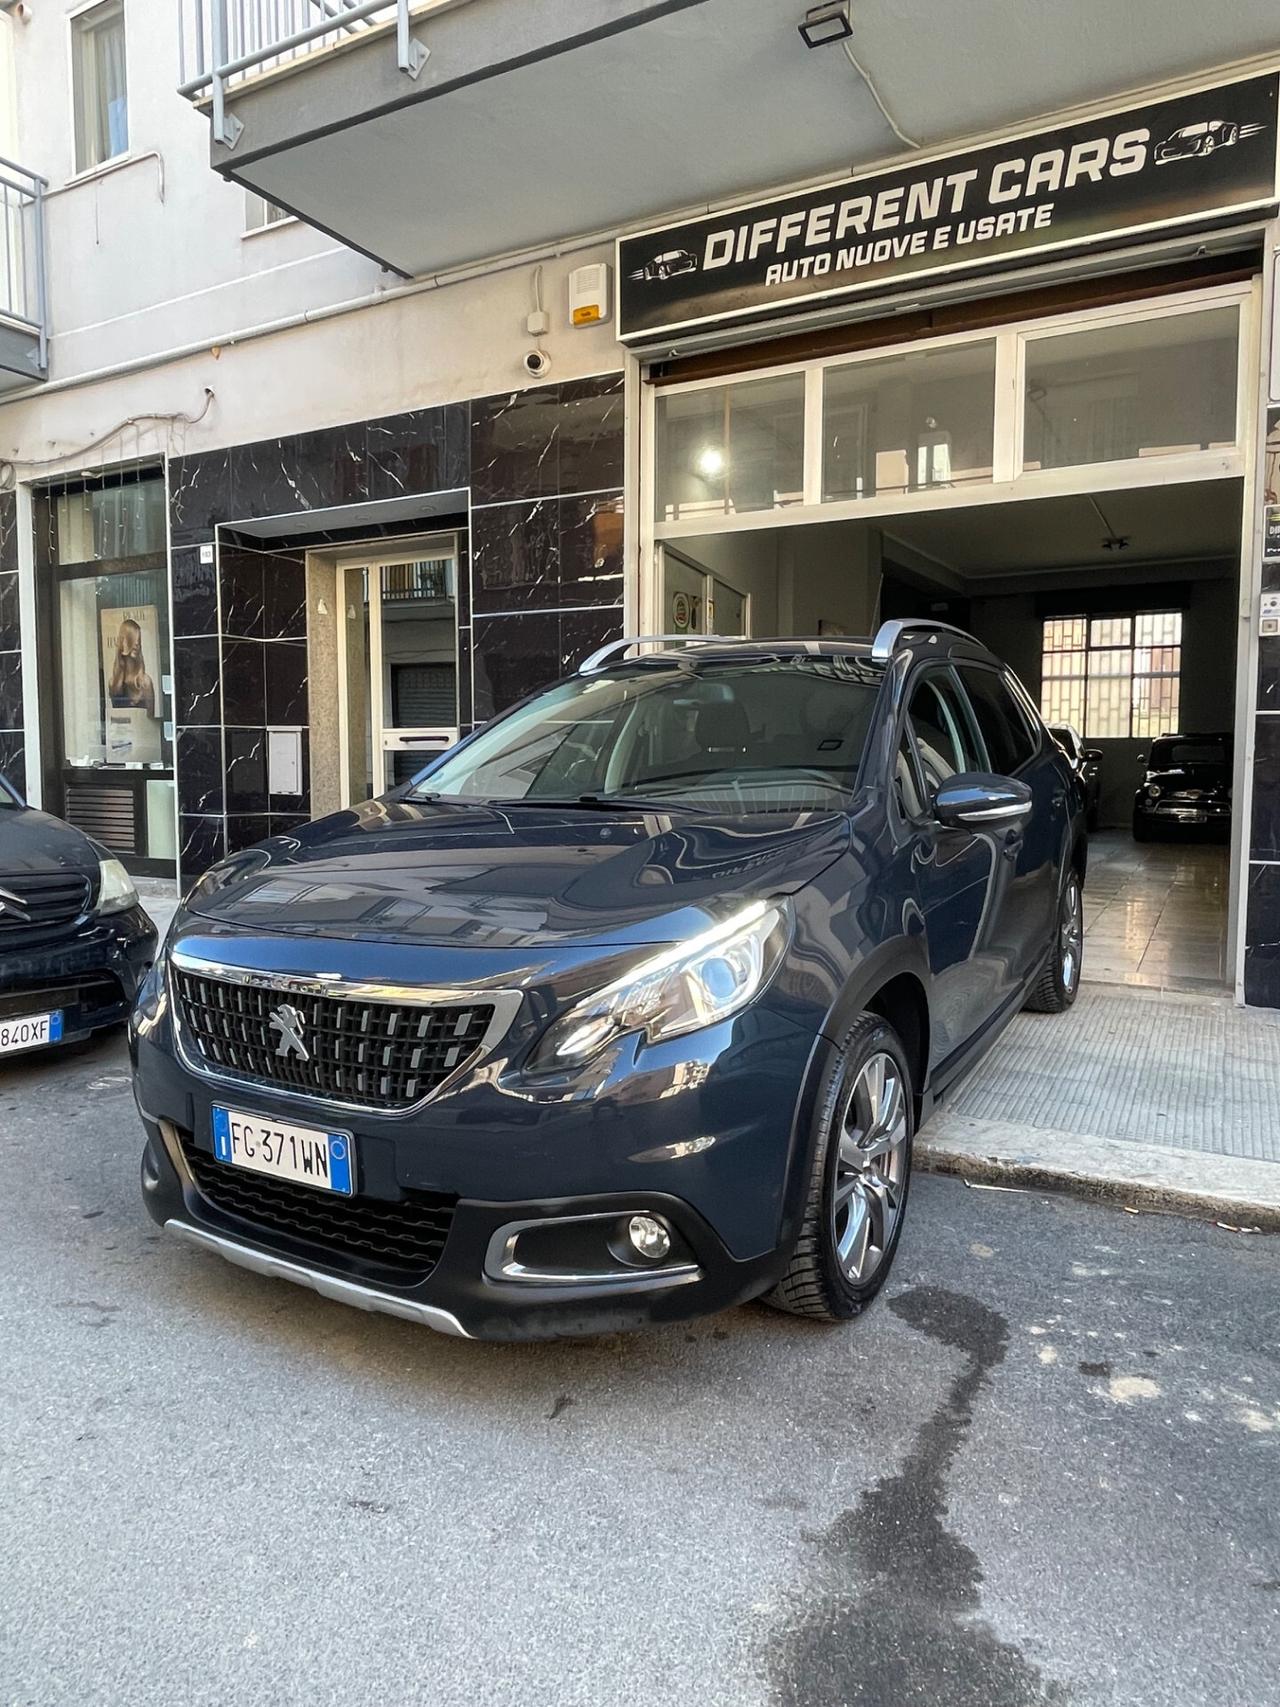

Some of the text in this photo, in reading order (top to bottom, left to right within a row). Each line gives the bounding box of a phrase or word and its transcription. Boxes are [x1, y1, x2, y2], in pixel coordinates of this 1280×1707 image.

[703, 128, 1151, 271] DIFFERENT CARS
[765, 203, 1055, 287] AUTO NUOVE E USATE
